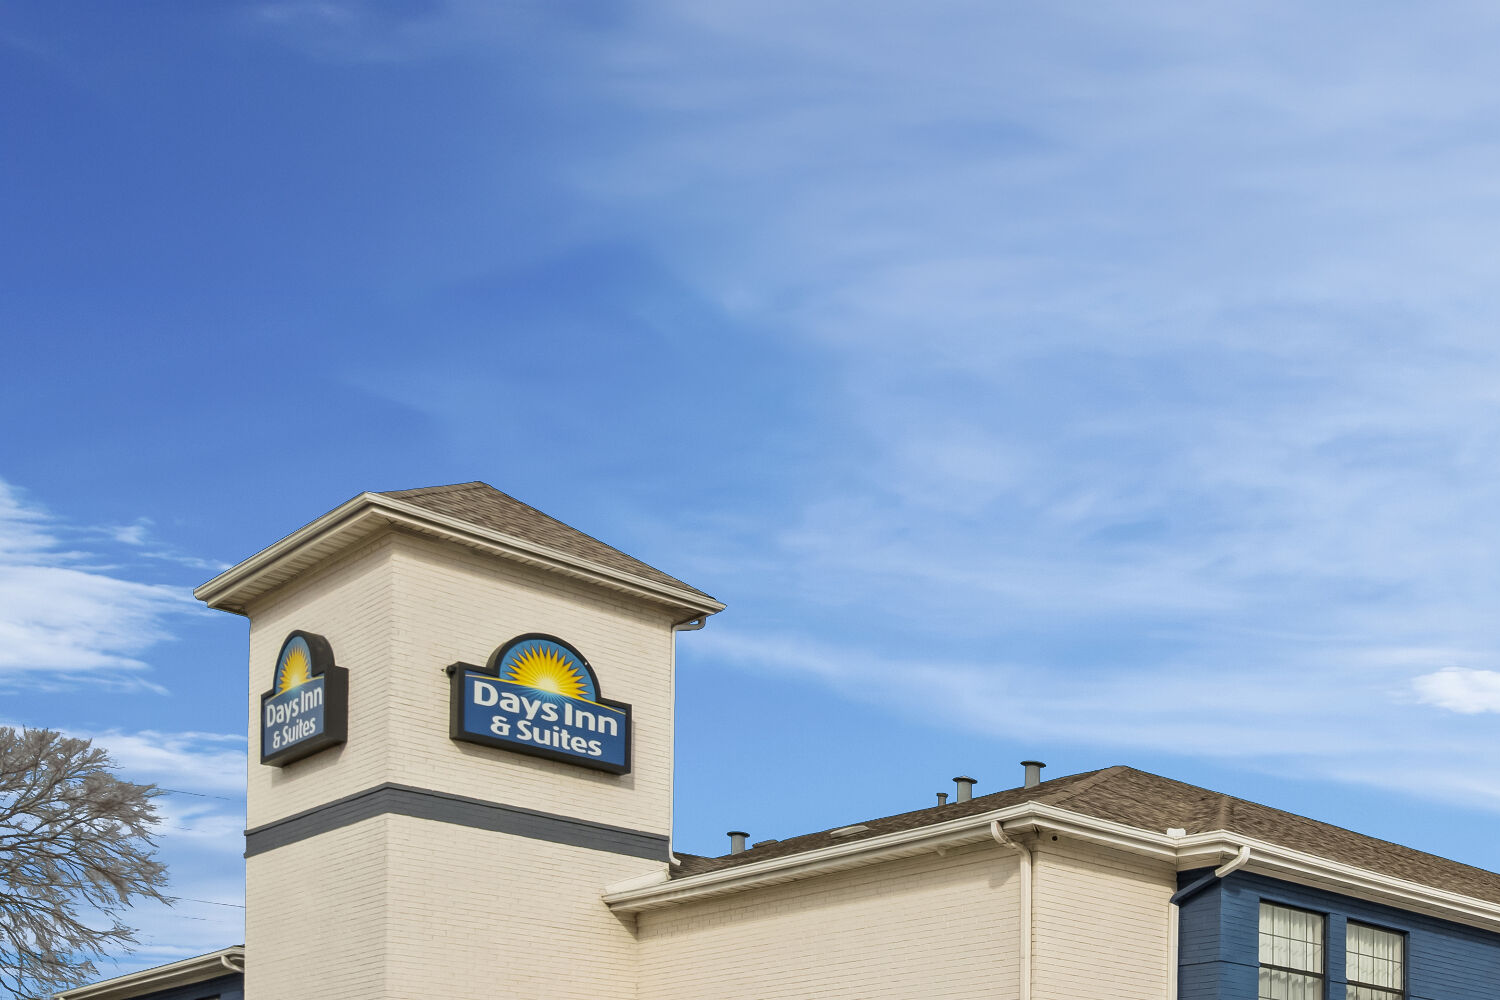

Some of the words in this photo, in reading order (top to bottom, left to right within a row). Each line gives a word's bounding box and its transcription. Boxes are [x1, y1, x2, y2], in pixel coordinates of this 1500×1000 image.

[266, 698, 299, 728] Days
[301, 687, 323, 713] Inn
[473, 680, 559, 720] Days
[564, 702, 618, 737] Inn
[273, 730, 281, 749] &
[282, 717, 316, 746] Suites
[490, 715, 511, 736] &
[516, 719, 602, 756] Suites
